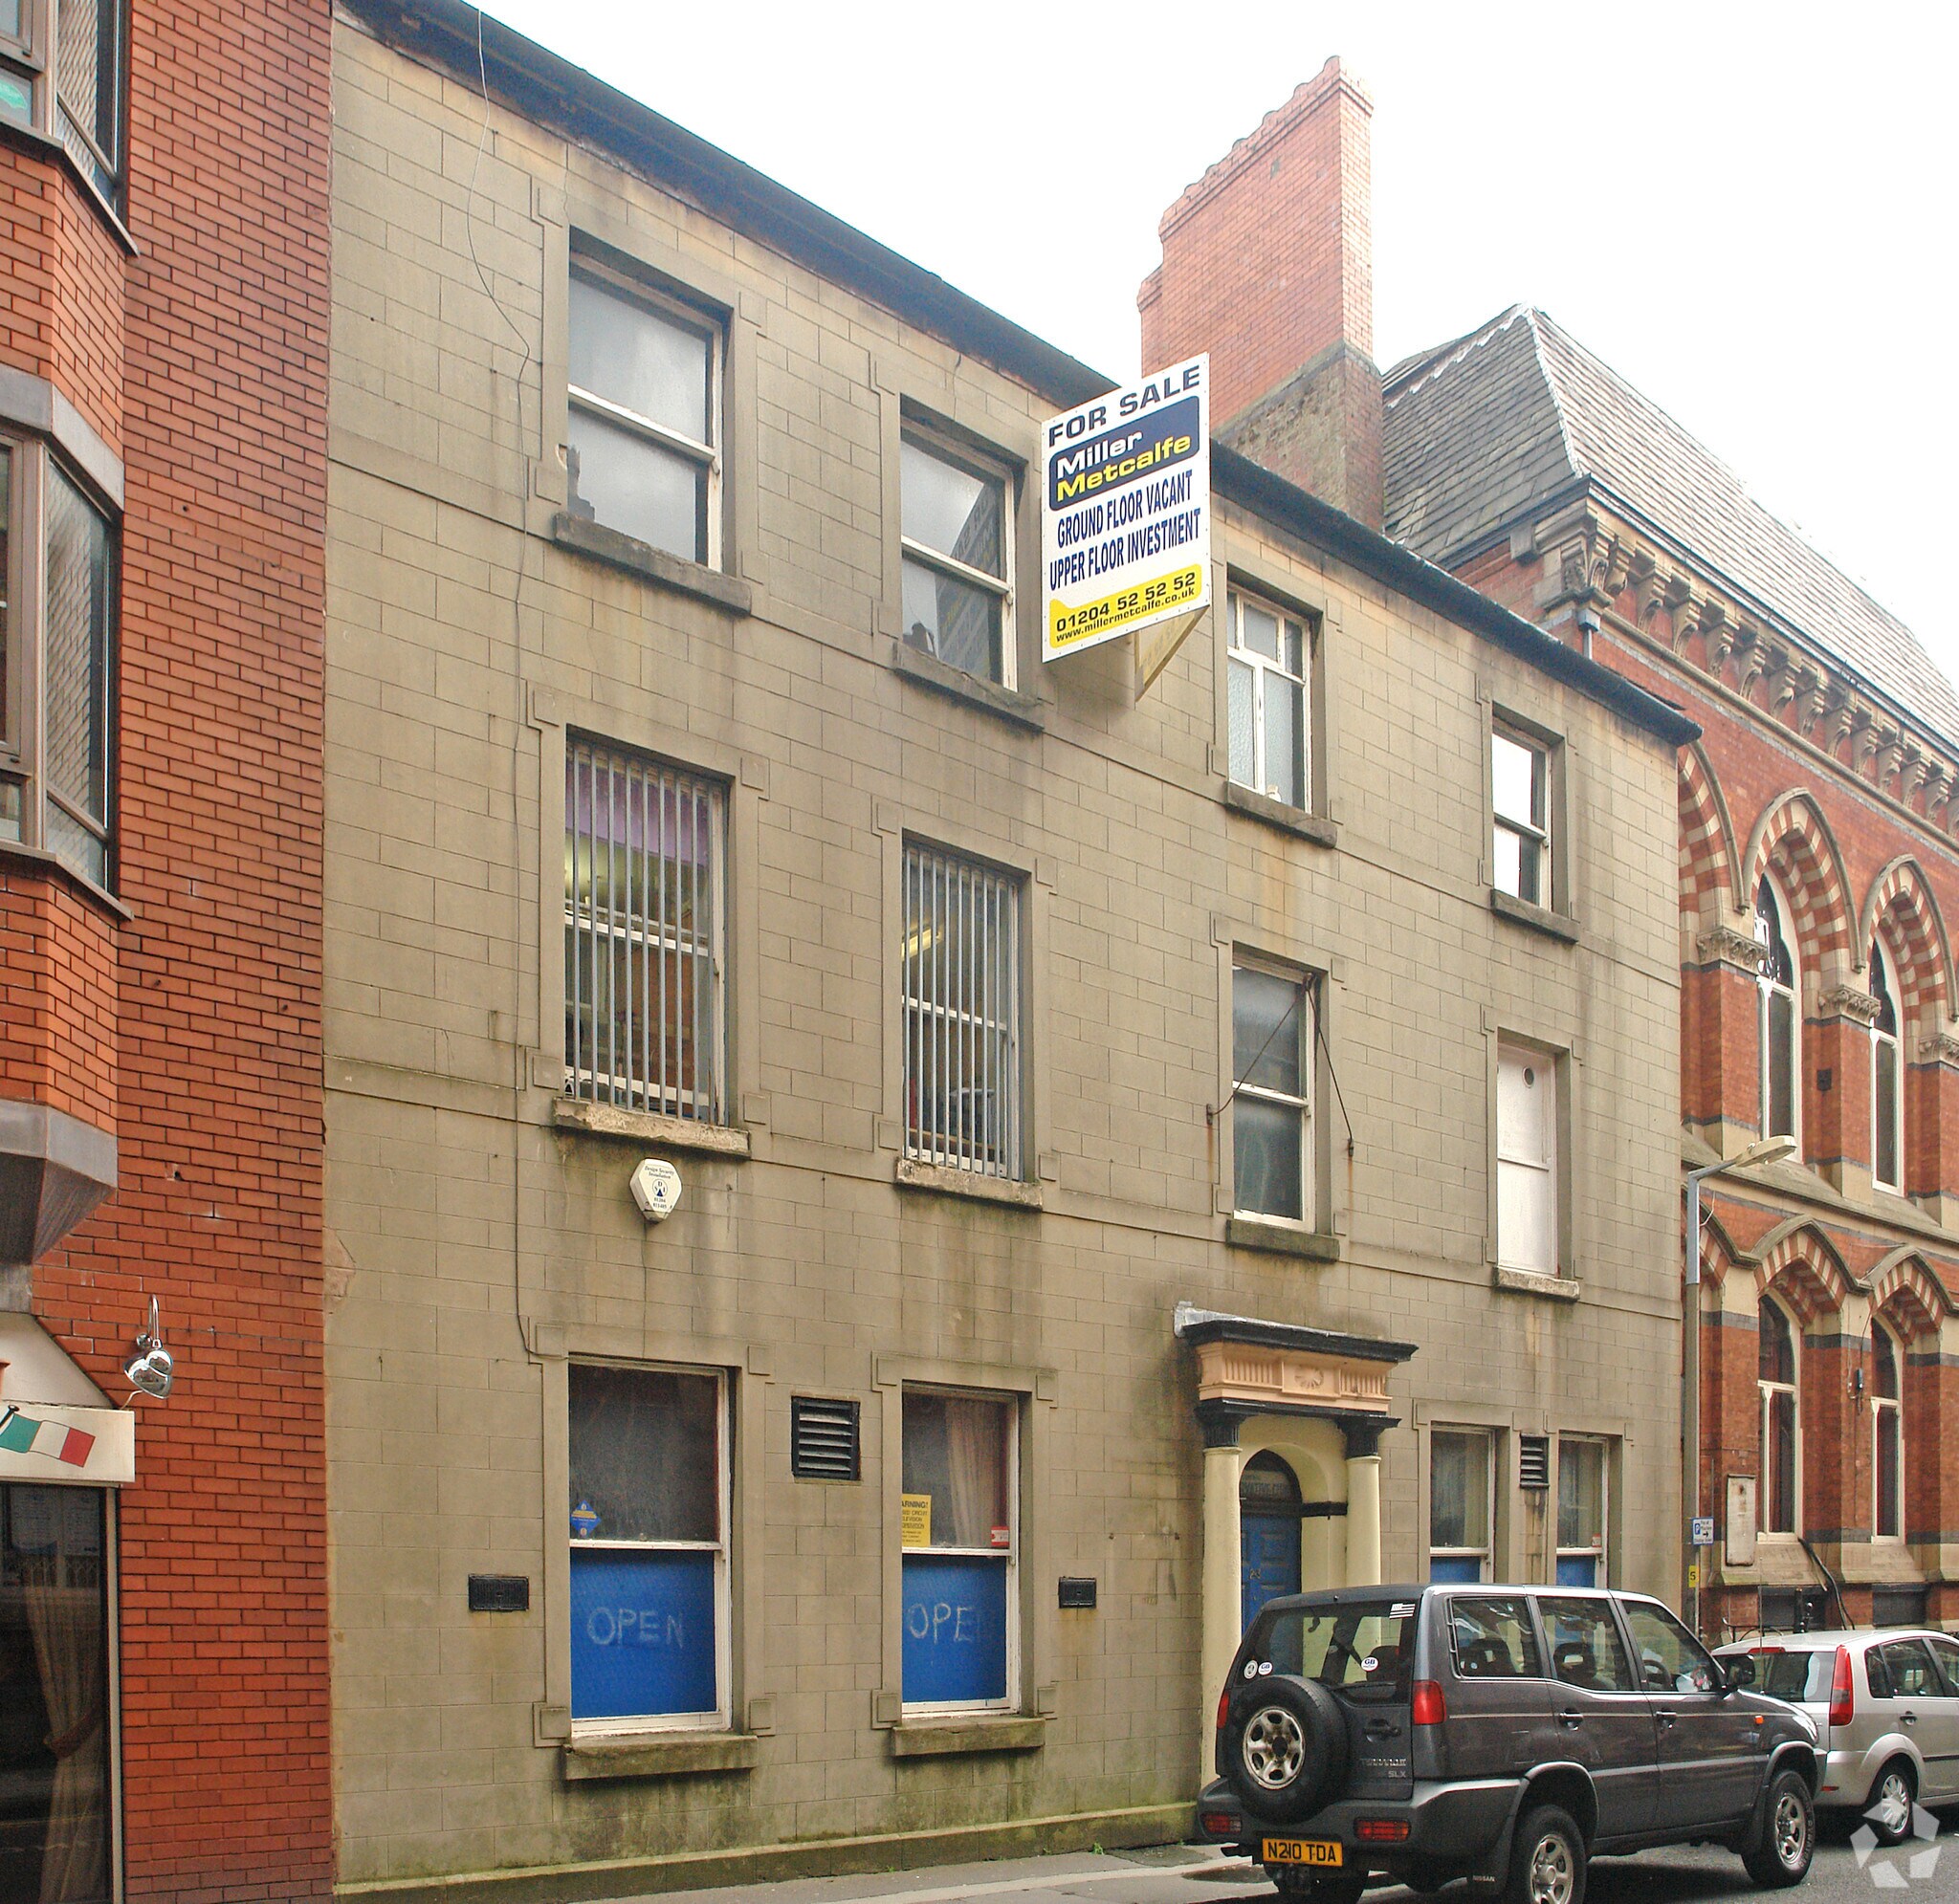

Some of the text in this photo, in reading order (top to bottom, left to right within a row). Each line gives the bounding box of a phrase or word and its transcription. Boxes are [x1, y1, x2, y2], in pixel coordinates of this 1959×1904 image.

[1049, 364, 1200, 448] FOR SALE
[1057, 430, 1143, 479] Miller
[1057, 435, 1192, 502] Metcalfe
[1057, 469, 1193, 549] GROUND FLOOR VACANT
[1049, 507, 1201, 591] UPPER FLOOR INVESTMENT
[1056, 572, 1196, 632] 01204 52 52 52
[1056, 586, 1195, 643] www.millermetcalfe.co.uk
[902, 1500, 929, 1509] ARNING!
[1689, 1571, 1696, 1581] 5
[587, 1608, 683, 1648] OPEN
[1267, 1841, 1336, 1862] N210 TDA
